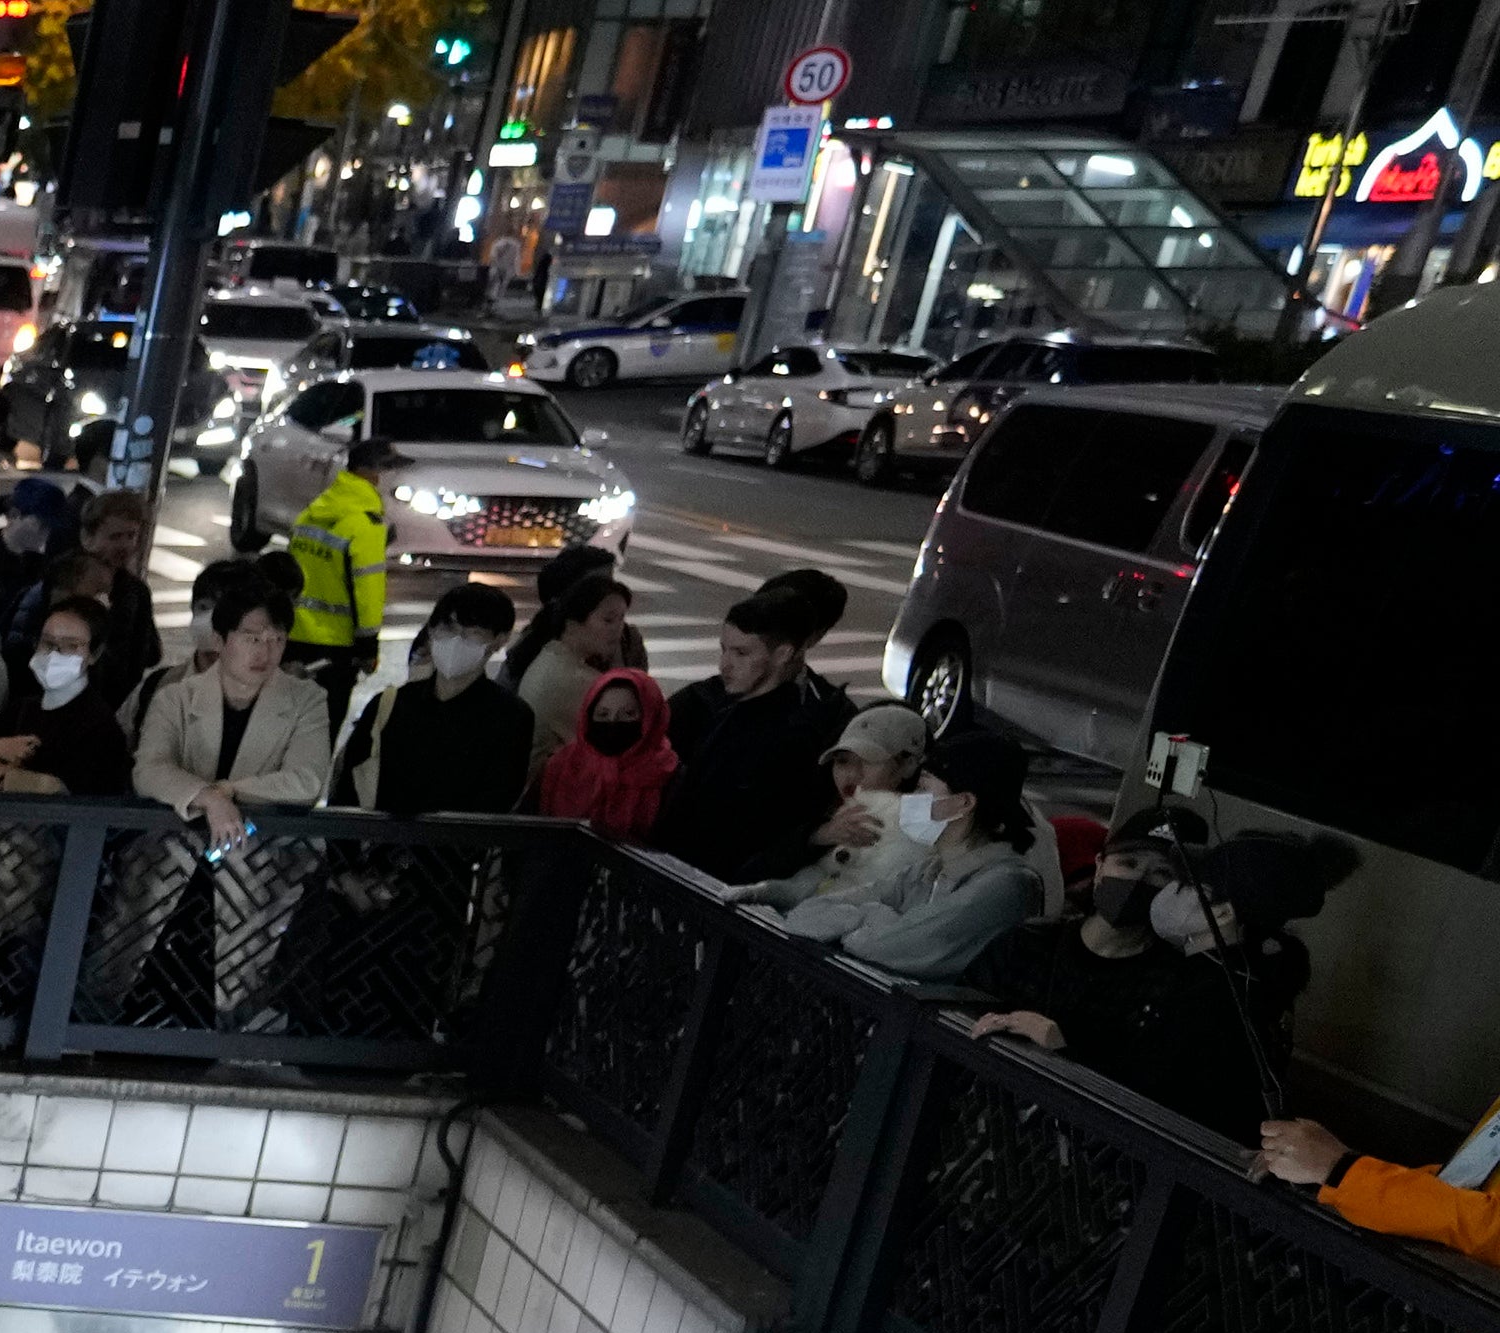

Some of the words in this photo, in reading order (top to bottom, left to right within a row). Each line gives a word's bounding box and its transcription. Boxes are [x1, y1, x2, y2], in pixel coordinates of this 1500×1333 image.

[799, 62, 835, 92] 50
[1303, 132, 1368, 167] Turksh
[15, 1230, 122, 1260] Itaewon
[11, 1261, 84, 1286] 梨泰院
[307, 1240, 325, 1285] 1
[103, 1267, 208, 1293] イテウォン
